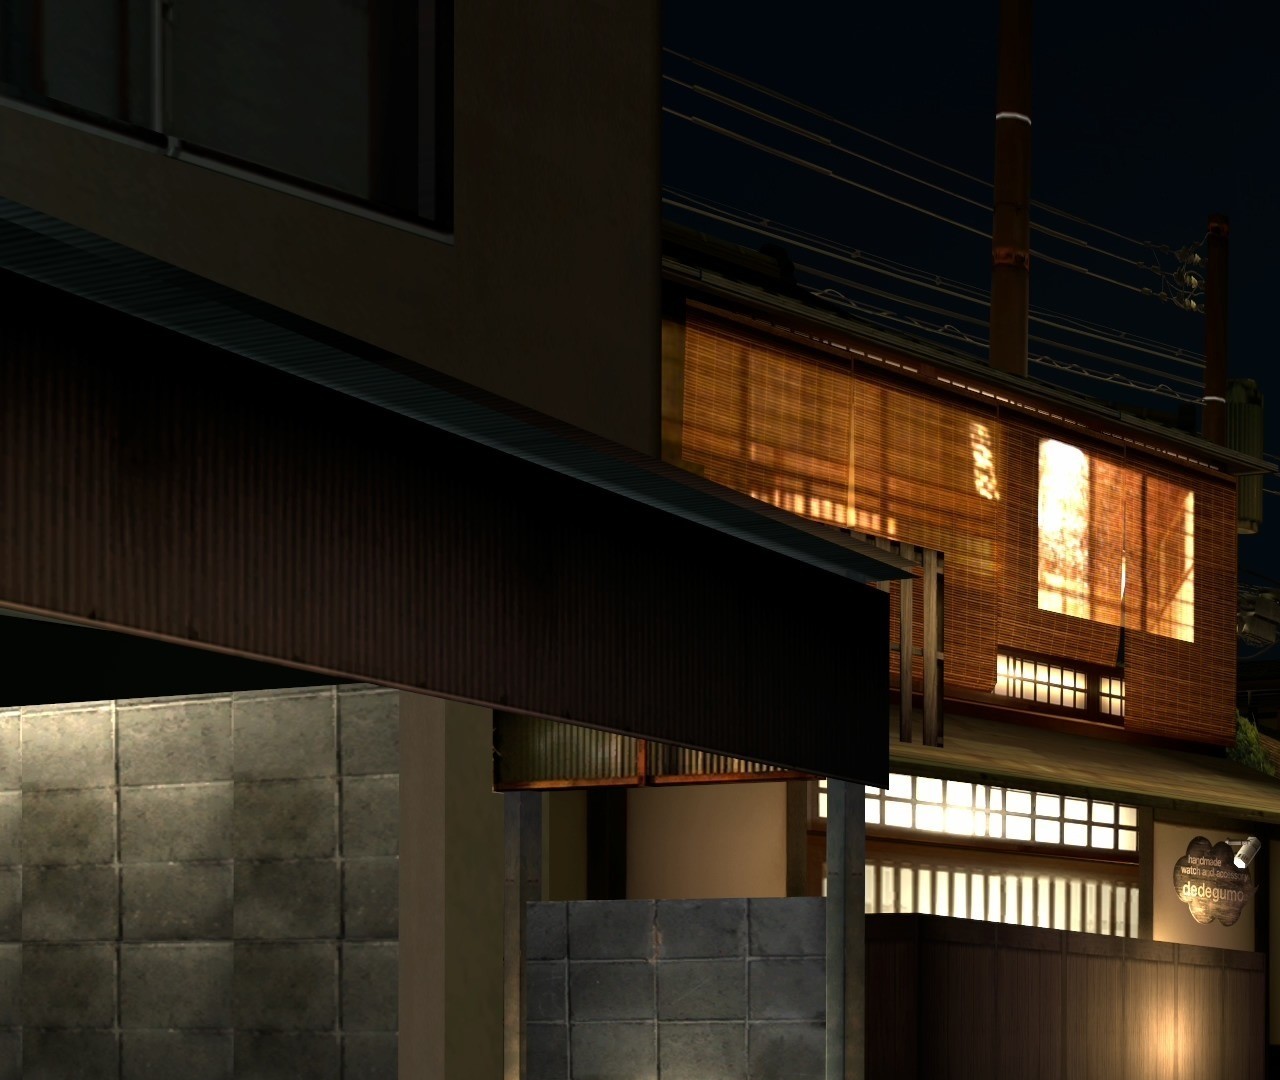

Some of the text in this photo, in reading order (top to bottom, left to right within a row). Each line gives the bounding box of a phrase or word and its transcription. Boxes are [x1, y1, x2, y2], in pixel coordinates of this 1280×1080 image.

[1188, 854, 1222, 867] handmade
[1181, 866, 1200, 876] watch
[1182, 881, 1244, 902] dedegumo
